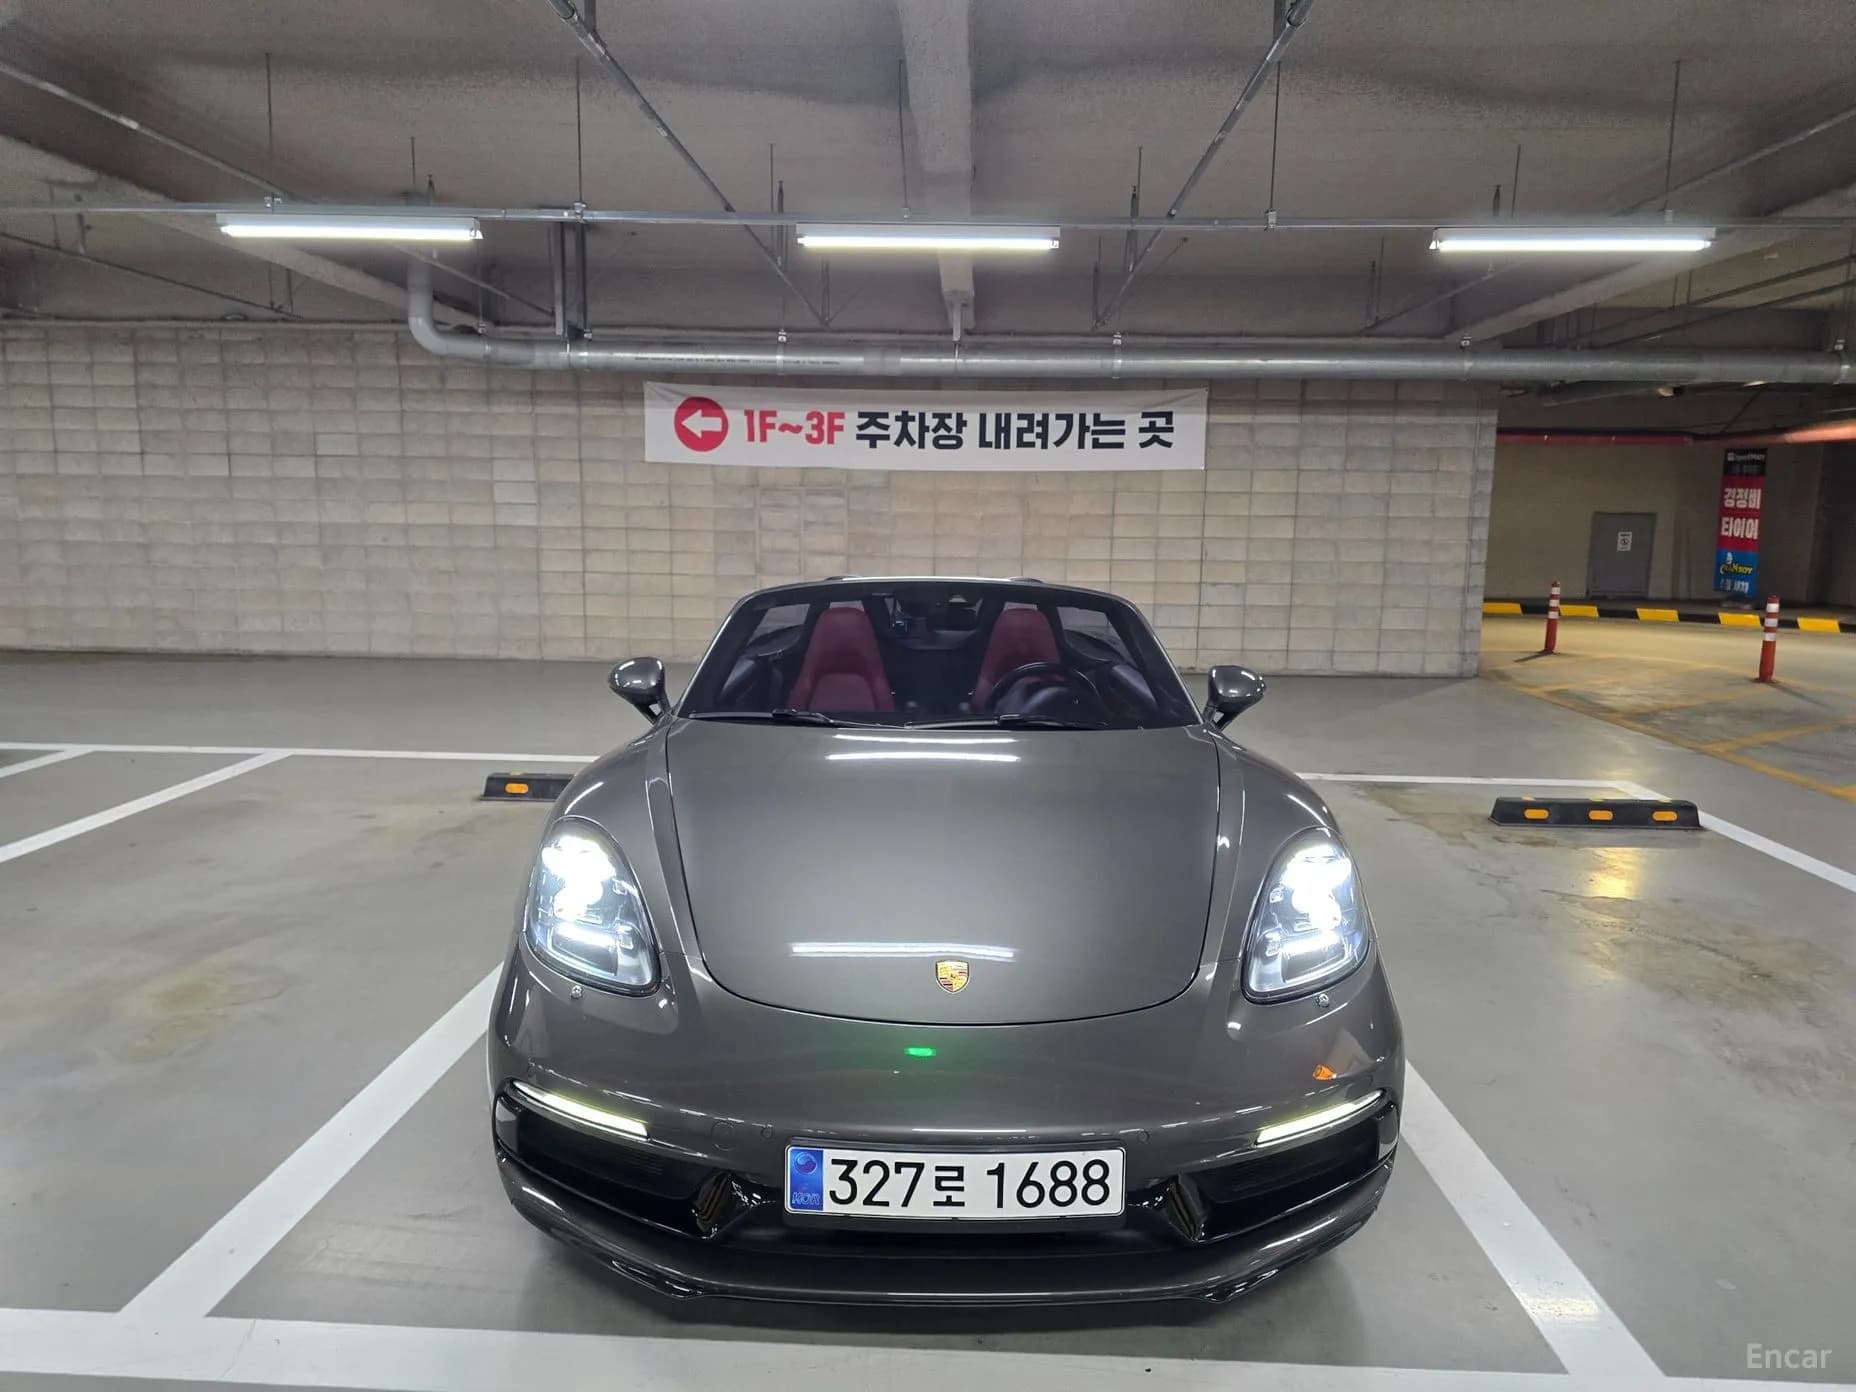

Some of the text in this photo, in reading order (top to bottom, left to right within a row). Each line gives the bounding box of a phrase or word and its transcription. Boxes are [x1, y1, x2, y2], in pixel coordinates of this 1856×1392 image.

[744, 409, 1175, 450] 1F~3F 주차장 내려가는 곳
[829, 1158, 1111, 1209] 327로 1688
